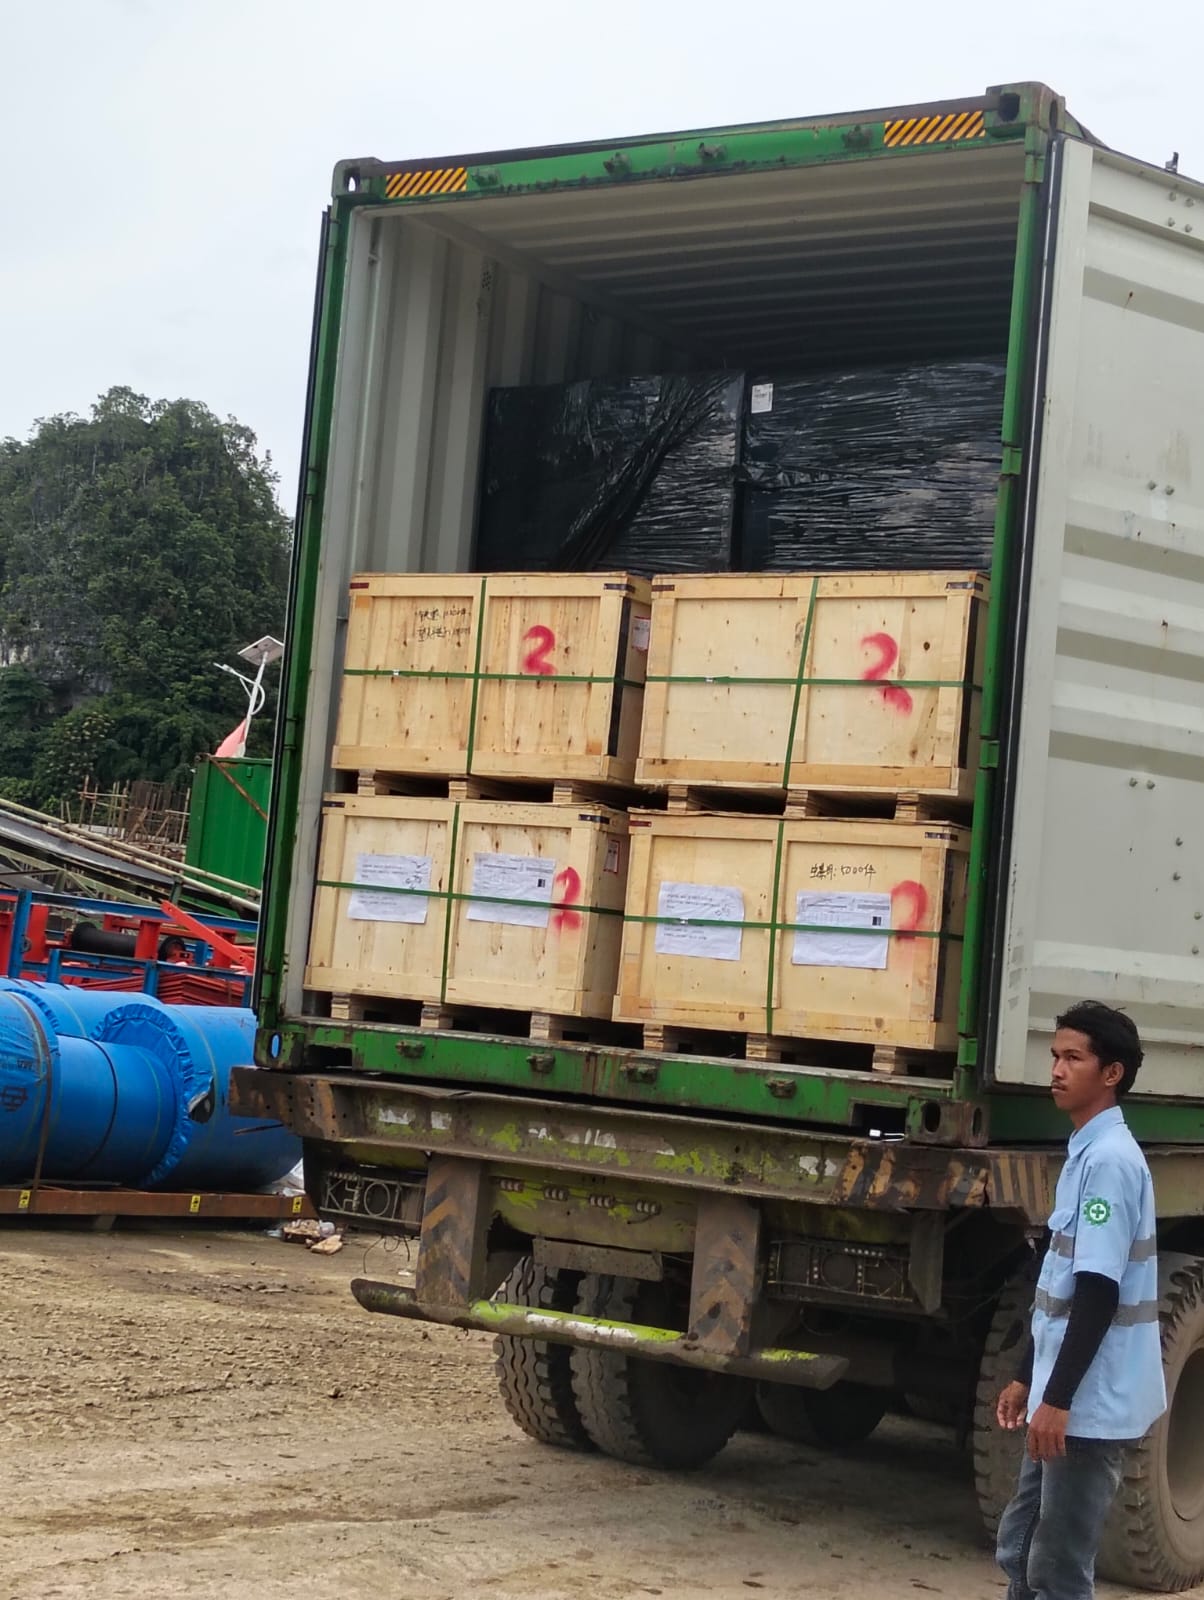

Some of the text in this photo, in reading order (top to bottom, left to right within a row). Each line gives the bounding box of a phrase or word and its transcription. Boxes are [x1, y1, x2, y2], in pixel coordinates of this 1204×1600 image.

[521, 624, 557, 675] 2
[860, 632, 912, 717] 2
[553, 866, 582, 933] 2
